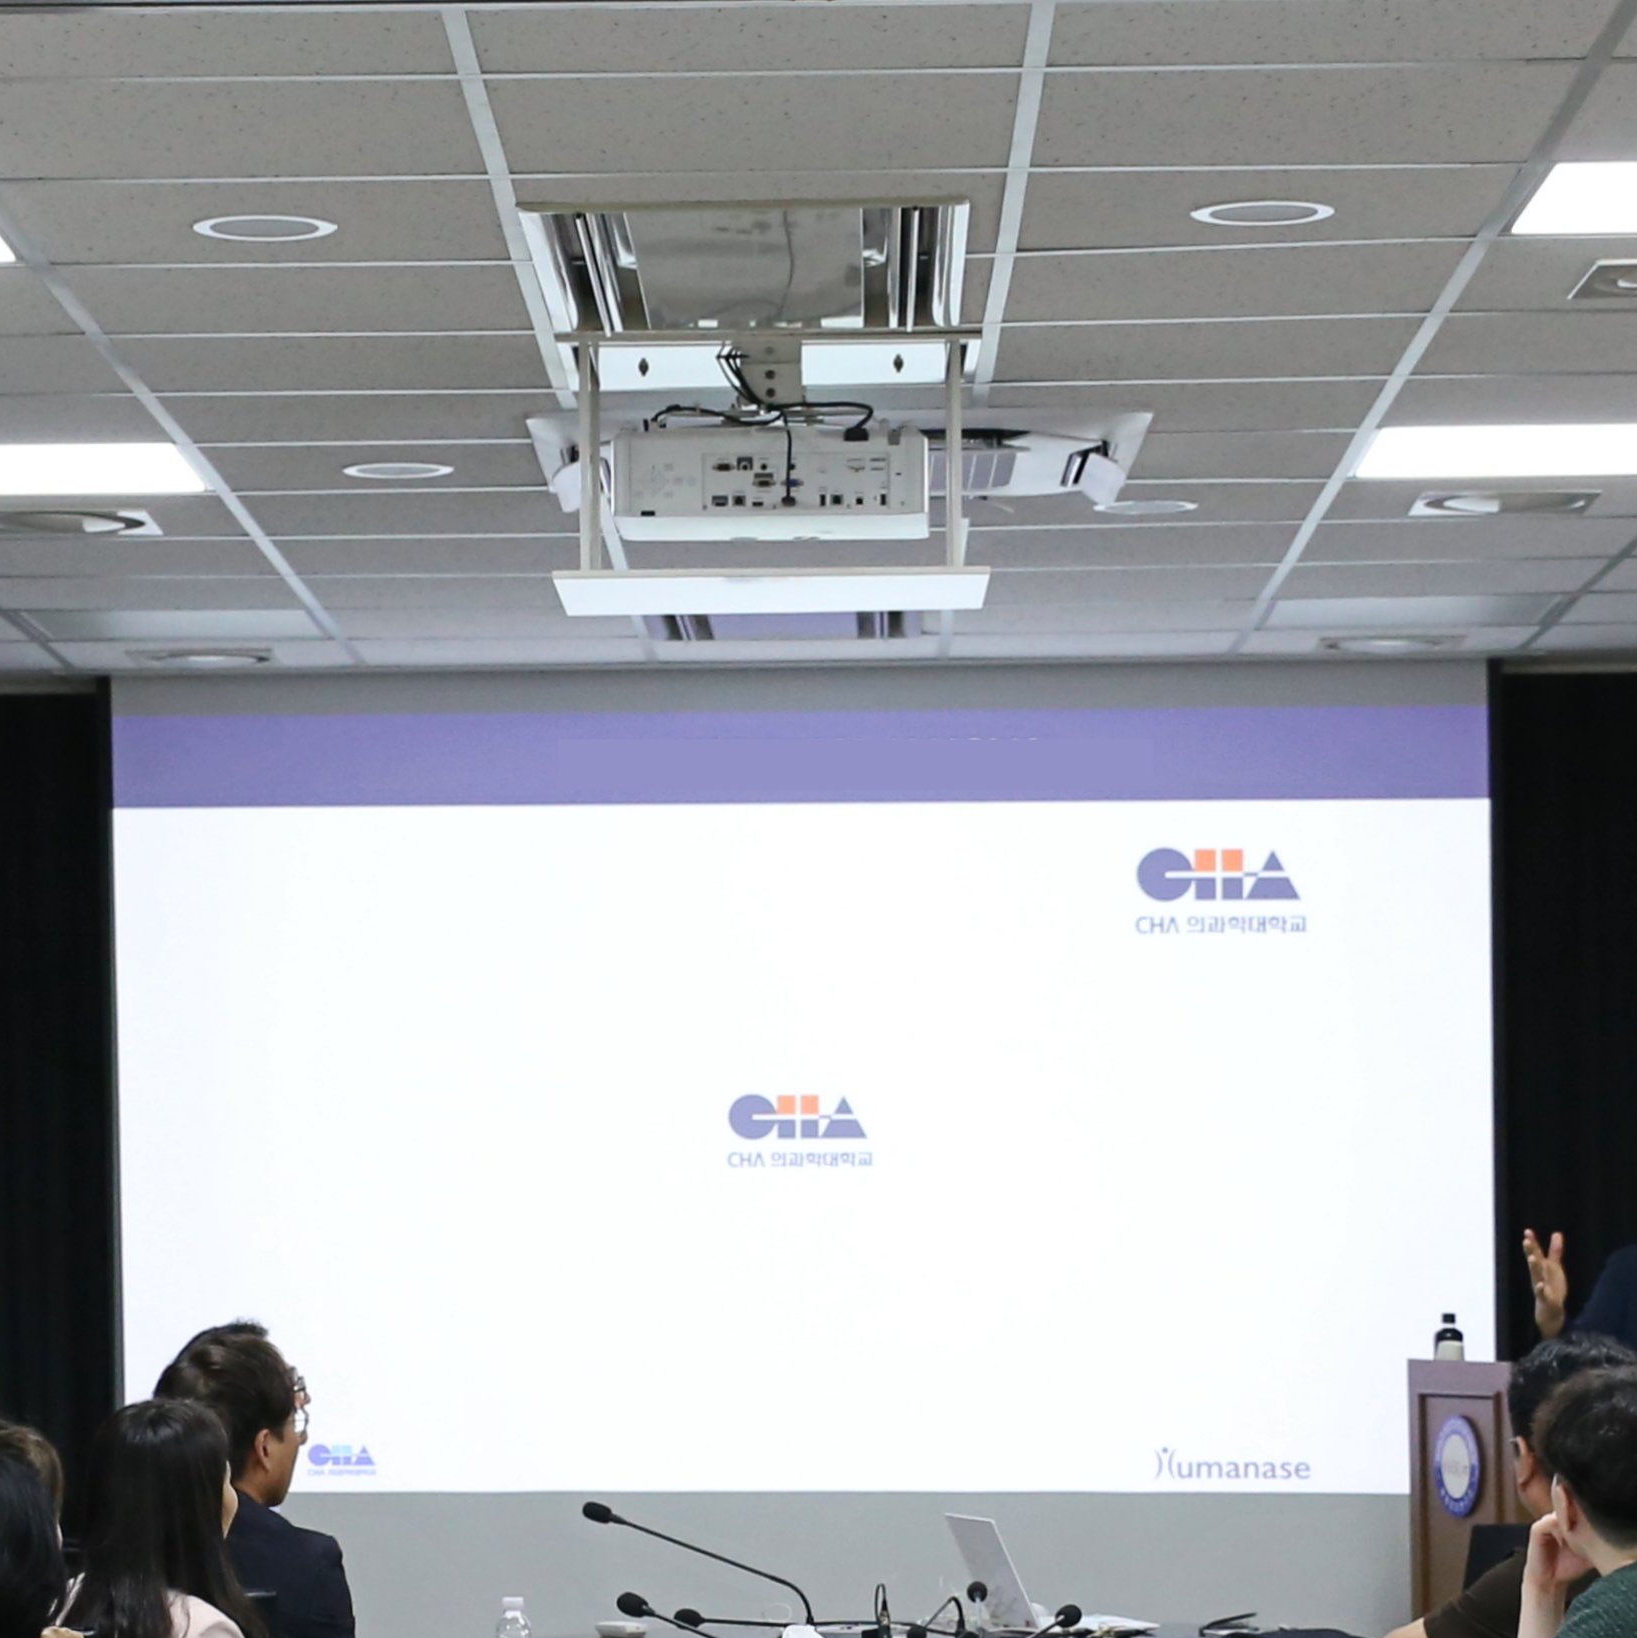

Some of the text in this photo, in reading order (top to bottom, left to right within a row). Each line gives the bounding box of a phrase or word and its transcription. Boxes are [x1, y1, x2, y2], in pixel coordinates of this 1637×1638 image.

[1135, 916, 1307, 934] CHA 의과학대학교
[727, 1152, 873, 1167] CHA 의과학대학교
